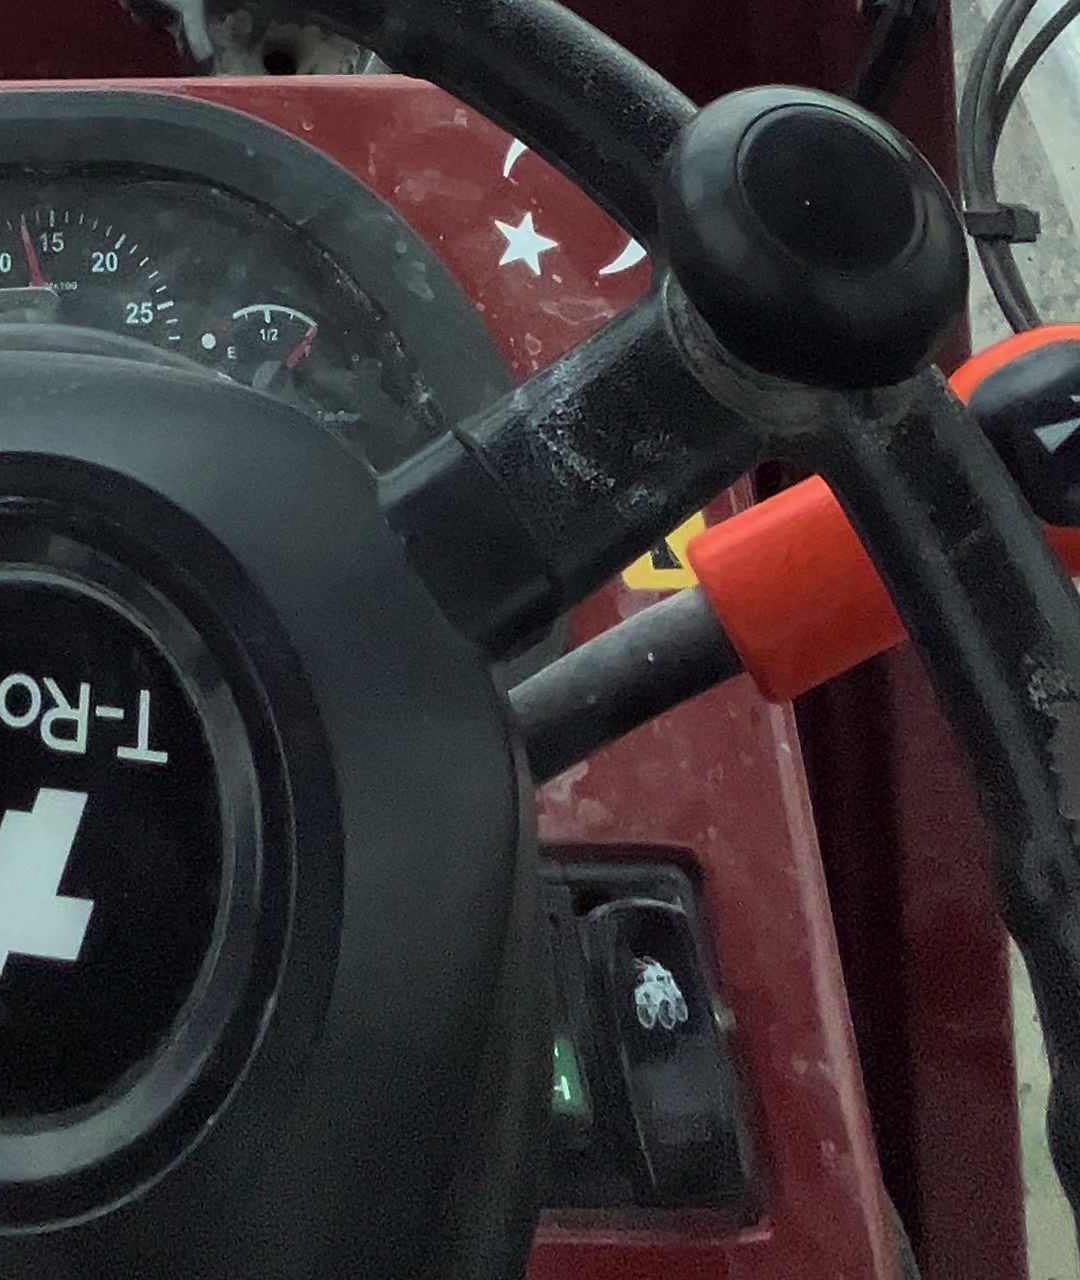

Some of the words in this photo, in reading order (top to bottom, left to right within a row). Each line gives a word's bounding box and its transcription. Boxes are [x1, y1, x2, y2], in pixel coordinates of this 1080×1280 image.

[40, 232, 64, 252] 15
[91, 251, 118, 272] 20
[125, 302, 153, 324] 25
[260, 329, 278, 341] 1/2
[227, 346, 237, 359] E
